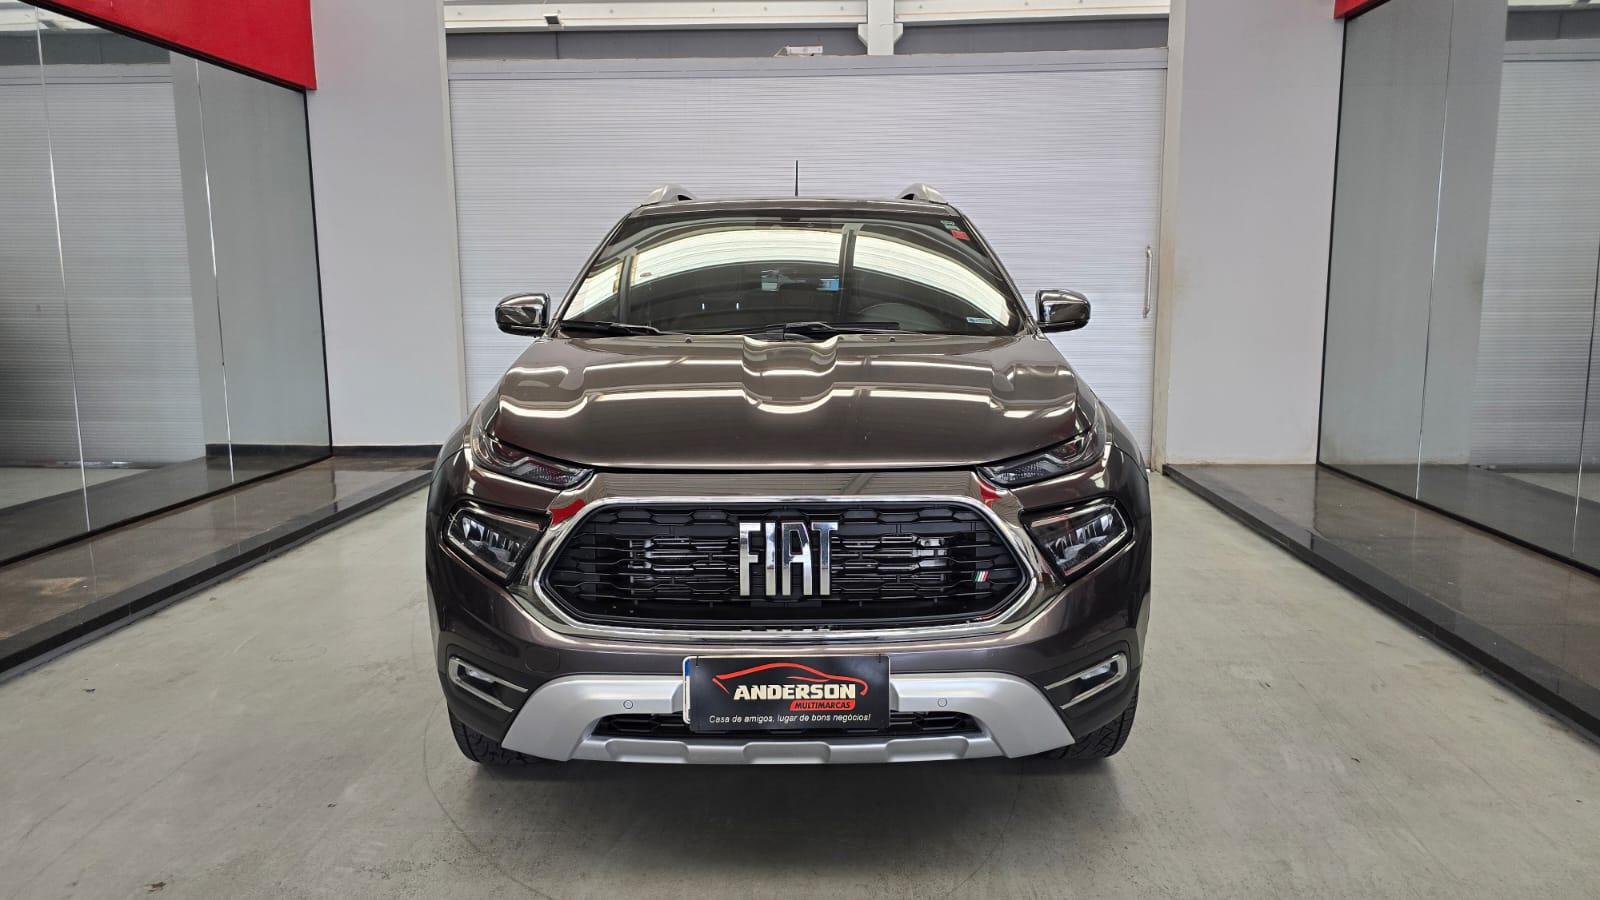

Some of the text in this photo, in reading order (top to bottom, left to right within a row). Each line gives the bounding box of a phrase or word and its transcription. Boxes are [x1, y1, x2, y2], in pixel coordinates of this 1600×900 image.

[739, 522, 838, 596] FIAT
[733, 684, 856, 700] ANDERSON
[794, 701, 851, 709] MULTIMARCAS
[709, 715, 729, 723] Casa
[732, 715, 742, 723] de
[777, 714, 797, 723] lugar
[800, 714, 809, 722] de
[812, 714, 831, 722] bons
